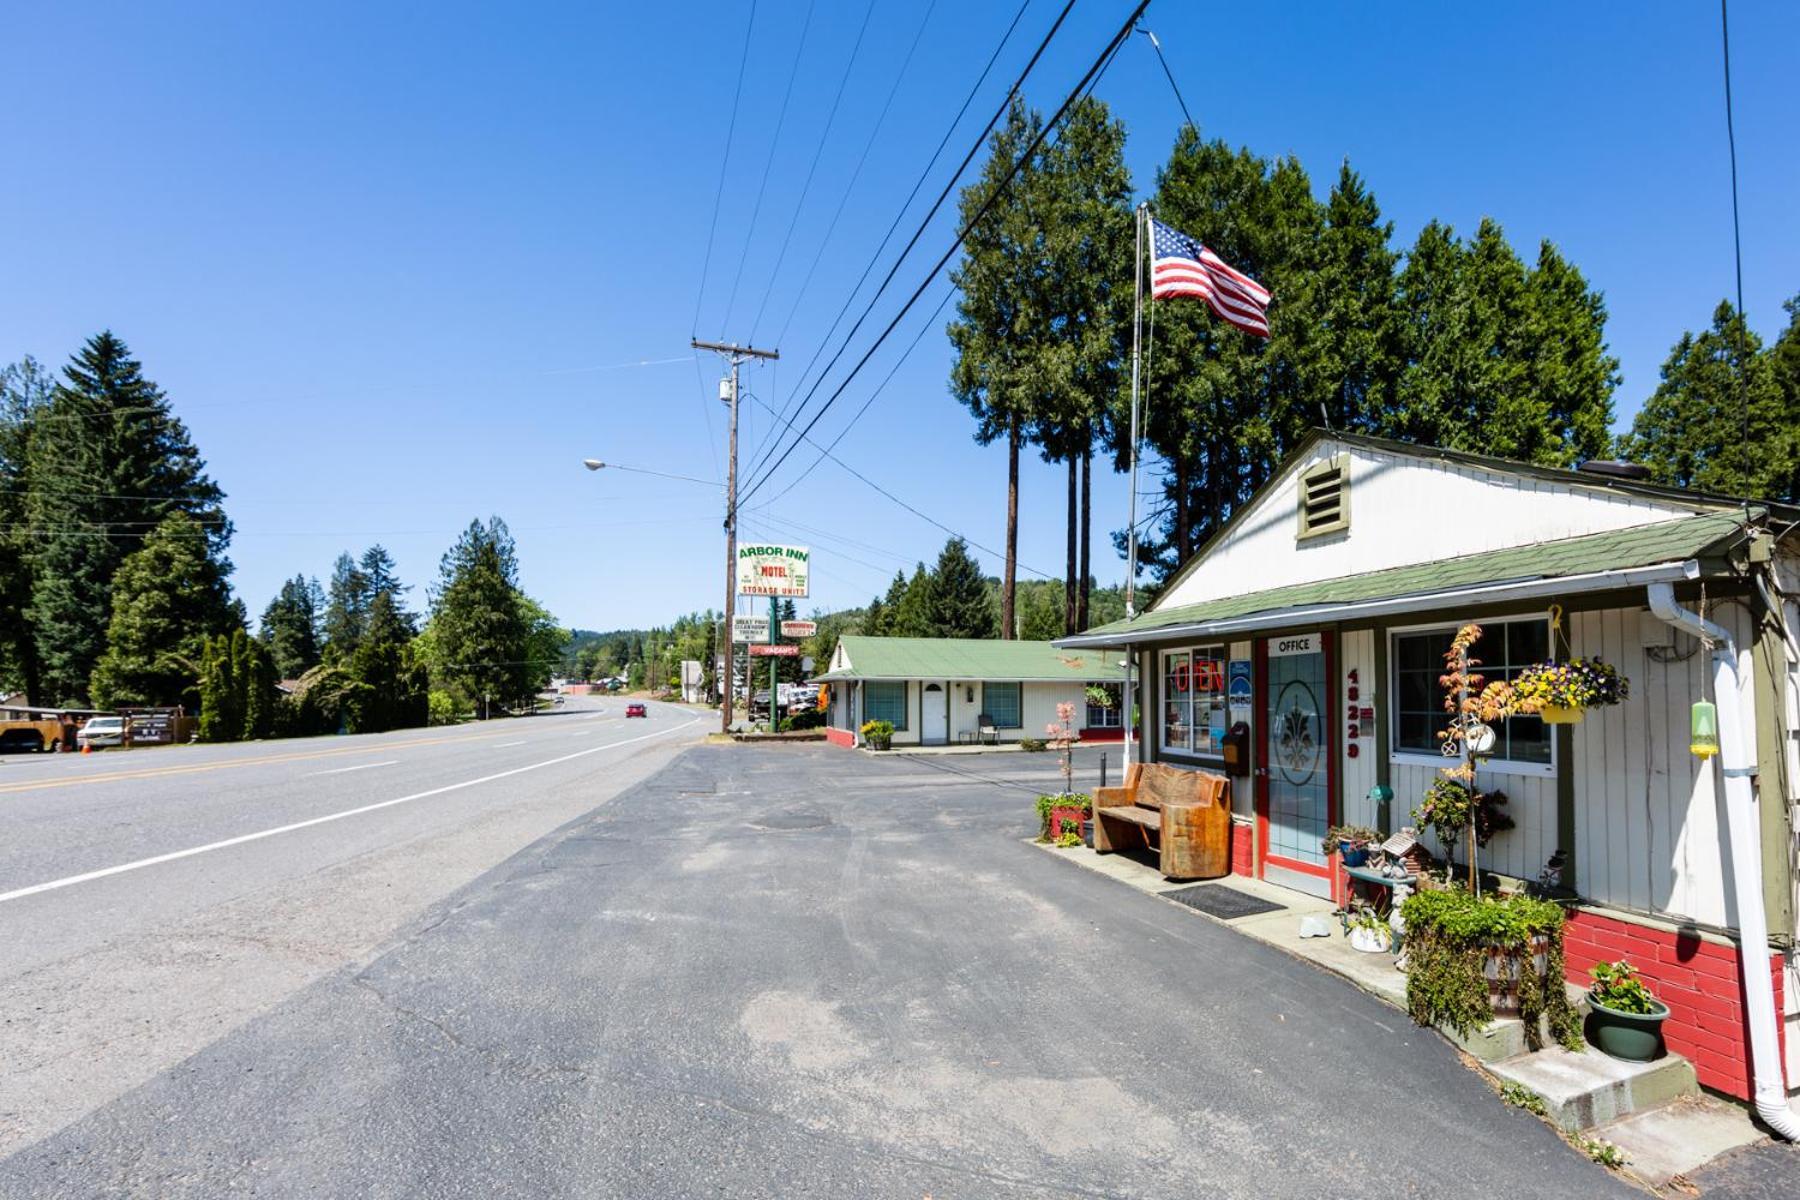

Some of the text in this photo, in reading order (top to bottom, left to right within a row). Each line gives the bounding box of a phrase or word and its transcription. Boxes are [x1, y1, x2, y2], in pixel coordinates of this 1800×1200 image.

[740, 546, 808, 562] ARBOR INN
[761, 566, 788, 577] MOTEL
[743, 586, 778, 595] STORAGE
[763, 646, 799, 655] VACANCY
[1278, 638, 1310, 652] OFFICE
